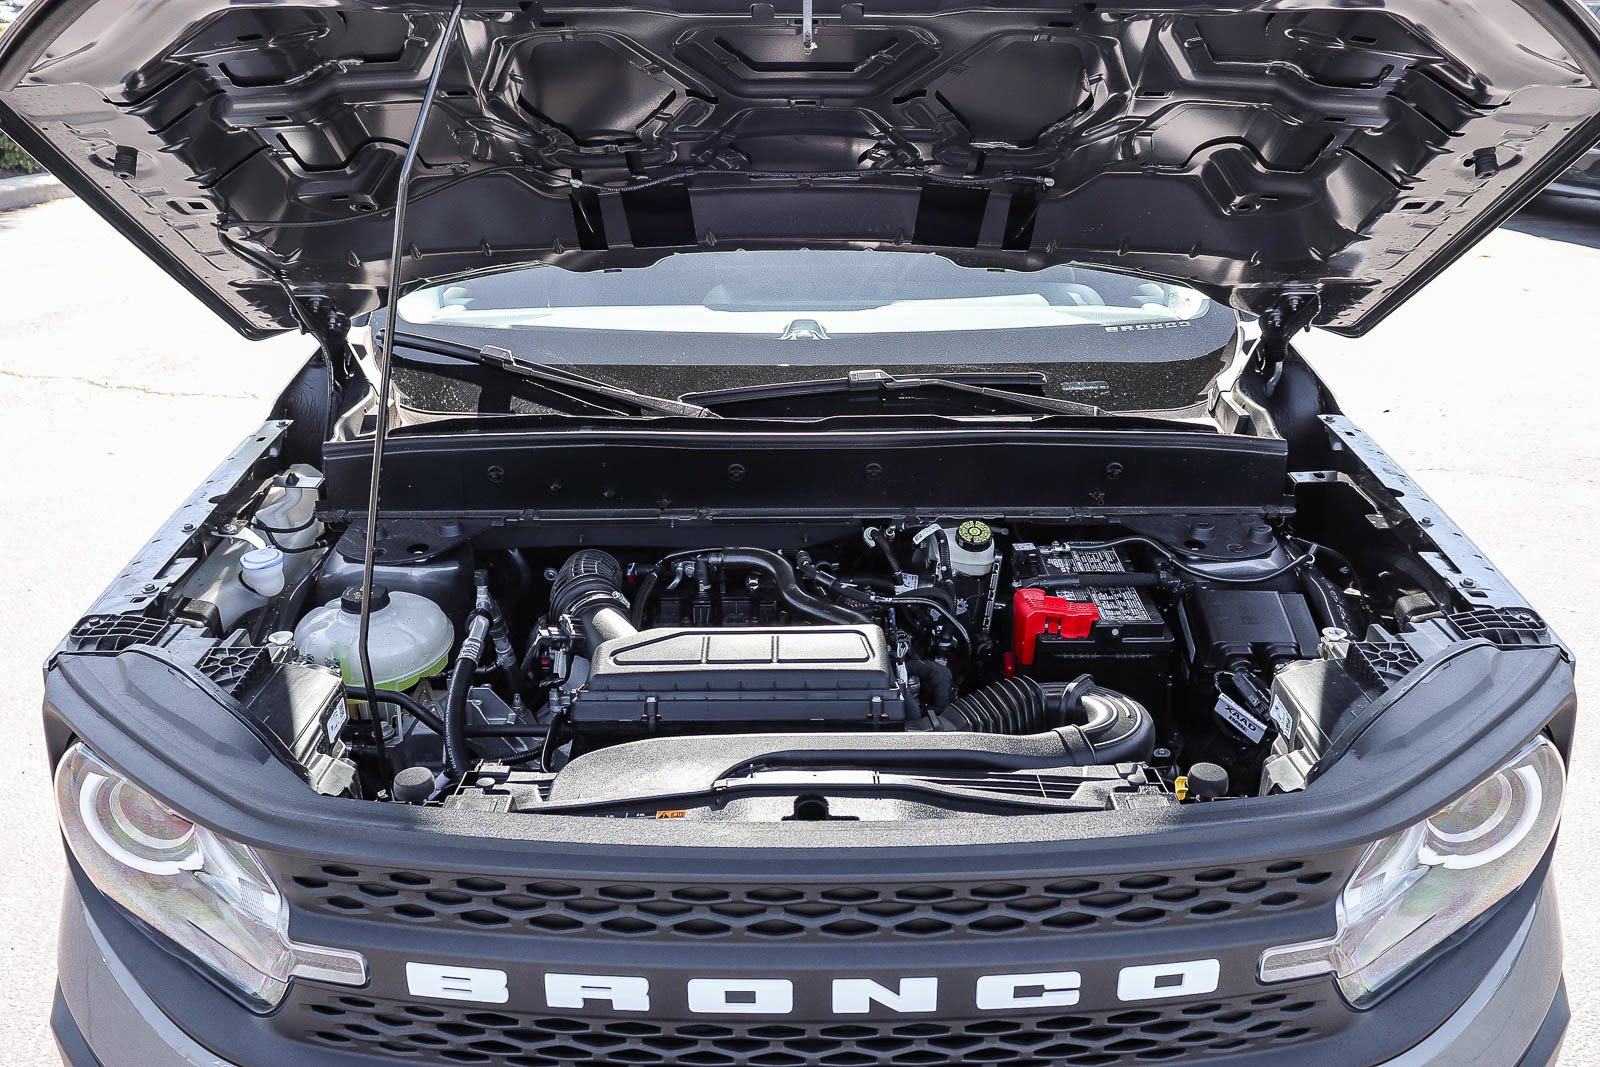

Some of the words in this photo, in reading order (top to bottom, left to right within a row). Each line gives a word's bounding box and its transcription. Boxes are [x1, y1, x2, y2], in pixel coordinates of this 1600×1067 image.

[1105, 321, 1191, 333] BRONCO
[1225, 705, 1257, 731] XAAD
[405, 958, 1221, 1014] BRONCO
